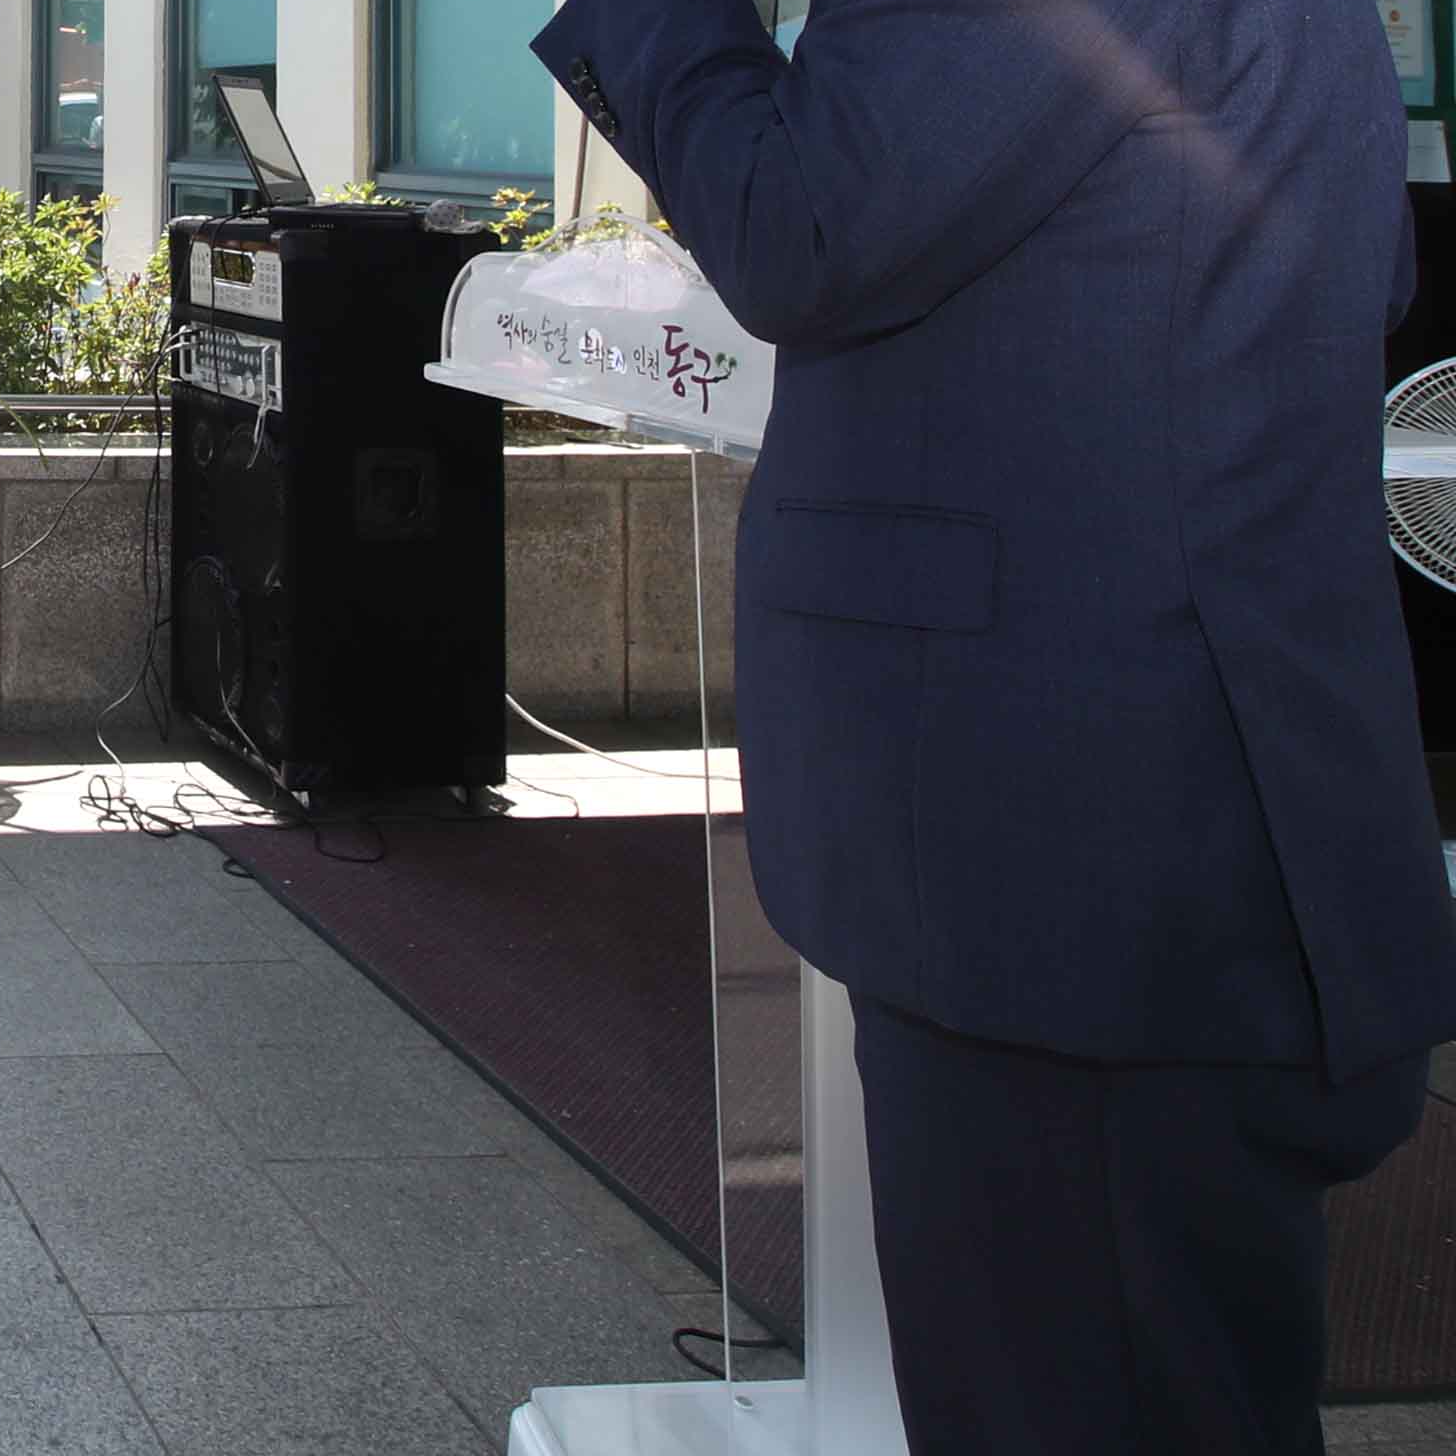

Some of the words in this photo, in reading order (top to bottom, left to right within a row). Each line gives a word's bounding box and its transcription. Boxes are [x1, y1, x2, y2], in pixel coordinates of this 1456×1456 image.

[497, 312, 537, 351] 역사의
[579, 329, 626, 373] 문화도시
[633, 345, 661, 381] 인천
[662, 324, 716, 414] 동구
